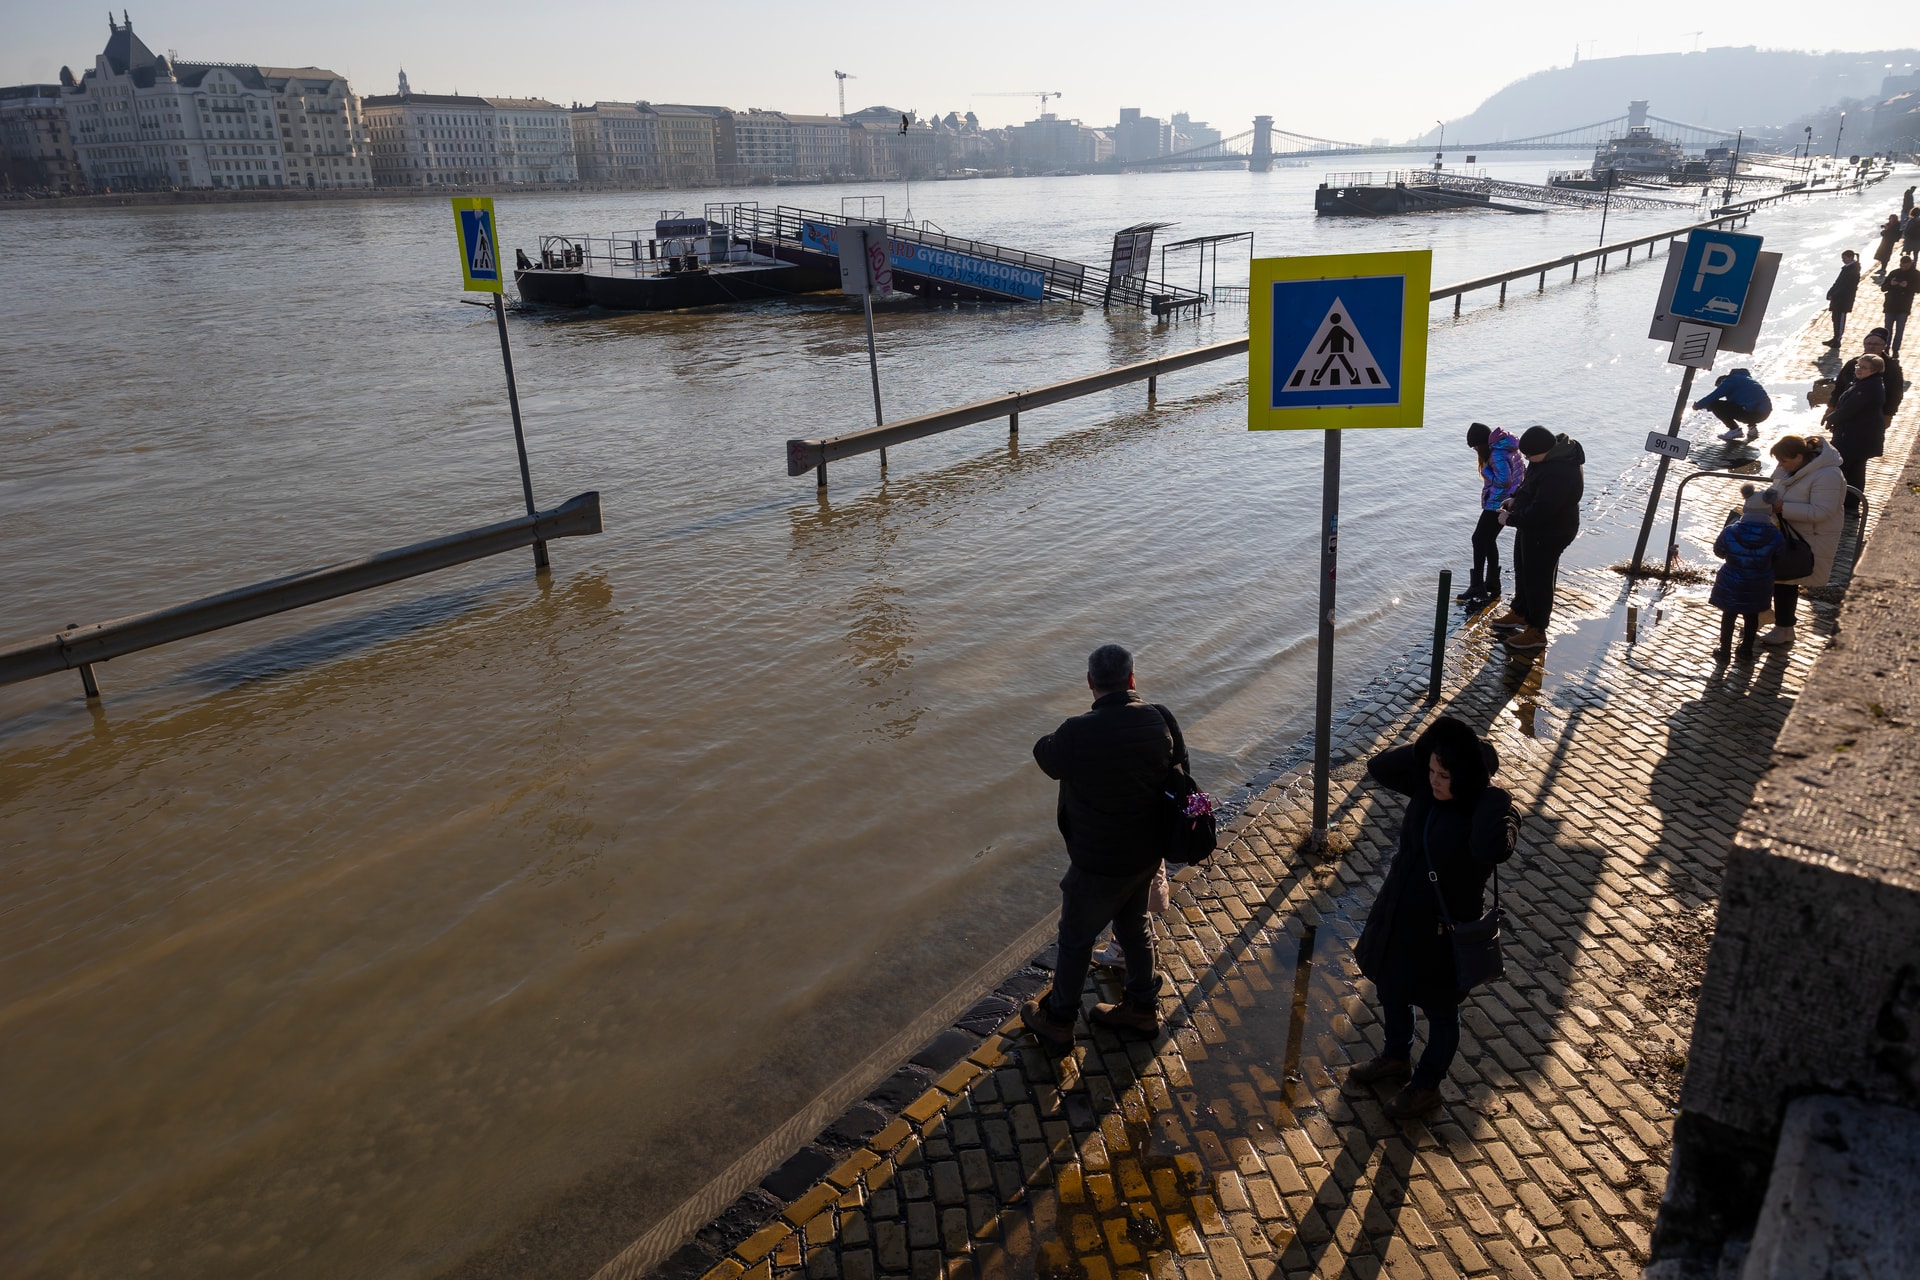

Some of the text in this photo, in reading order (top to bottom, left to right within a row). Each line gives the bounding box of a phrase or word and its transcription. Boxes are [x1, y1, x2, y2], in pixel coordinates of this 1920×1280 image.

[917, 248, 1043, 287] GYEREKTÁBOROK
[929, 263, 943, 276] 06
[993, 280, 1025, 295] 8140
[1692, 241, 1736, 293] P
[1655, 438, 1680, 454] 90 m
